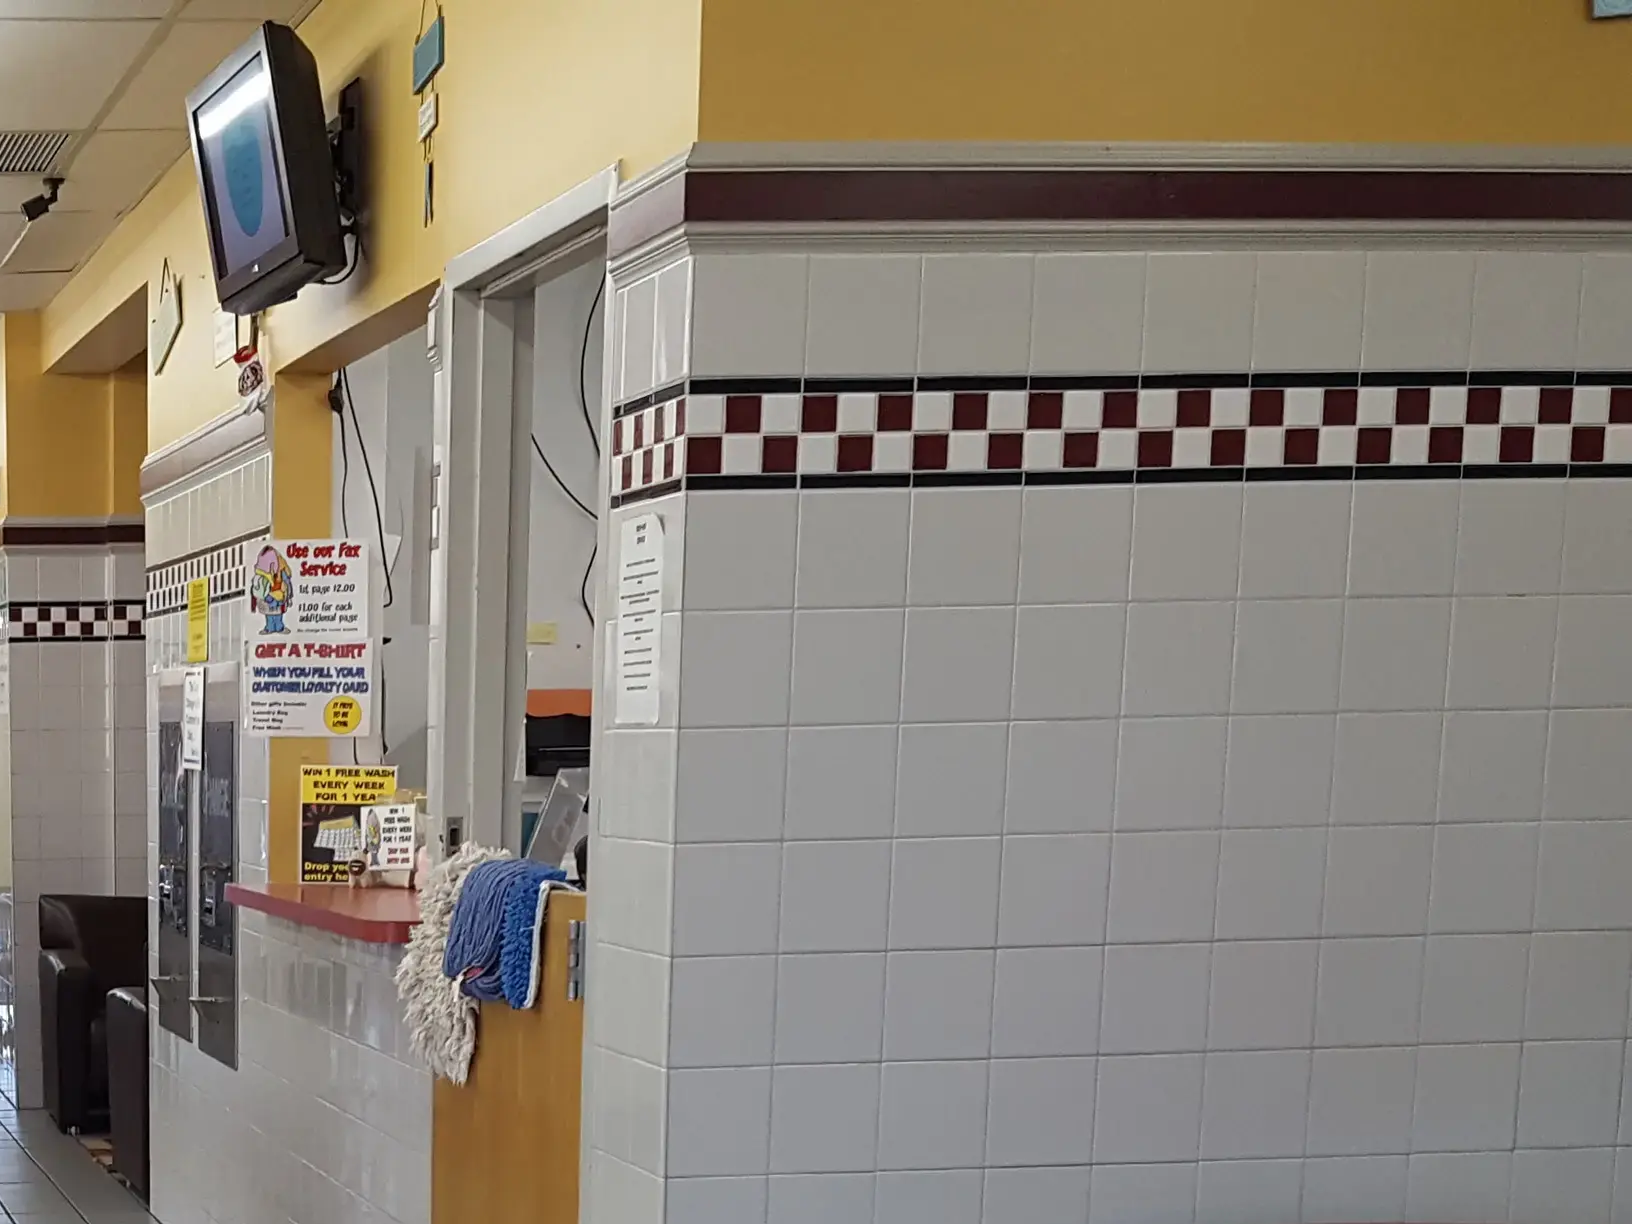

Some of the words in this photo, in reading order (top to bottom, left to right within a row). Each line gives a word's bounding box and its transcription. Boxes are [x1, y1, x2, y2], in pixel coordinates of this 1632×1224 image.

[287, 543, 309, 559] Use
[314, 545, 335, 558] our
[339, 542, 362, 558] Fax
[300, 561, 347, 577] Service
[312, 585, 331, 595] page
[322, 602, 333, 611] for
[335, 601, 353, 611] each
[299, 613, 337, 623] additional
[339, 614, 358, 624] page
[255, 643, 287, 659] GET
[288, 643, 301, 658] A
[304, 643, 366, 659] T-SHIRT
[253, 667, 287, 678] WHEN
[288, 667, 311, 679] YOU
[334, 667, 365, 679] YOUR
[302, 768, 323, 777] WIN
[326, 769, 331, 777] 1
[335, 769, 361, 777] FREE
[364, 769, 396, 778] WASH
[313, 781, 349, 789] EVERY
[353, 781, 385, 790] WEEK
[315, 793, 338, 801] FOR
[342, 793, 347, 801] 1
[353, 793, 376, 801] YEA
[304, 862, 330, 872] Drop
[304, 873, 333, 882] entry
